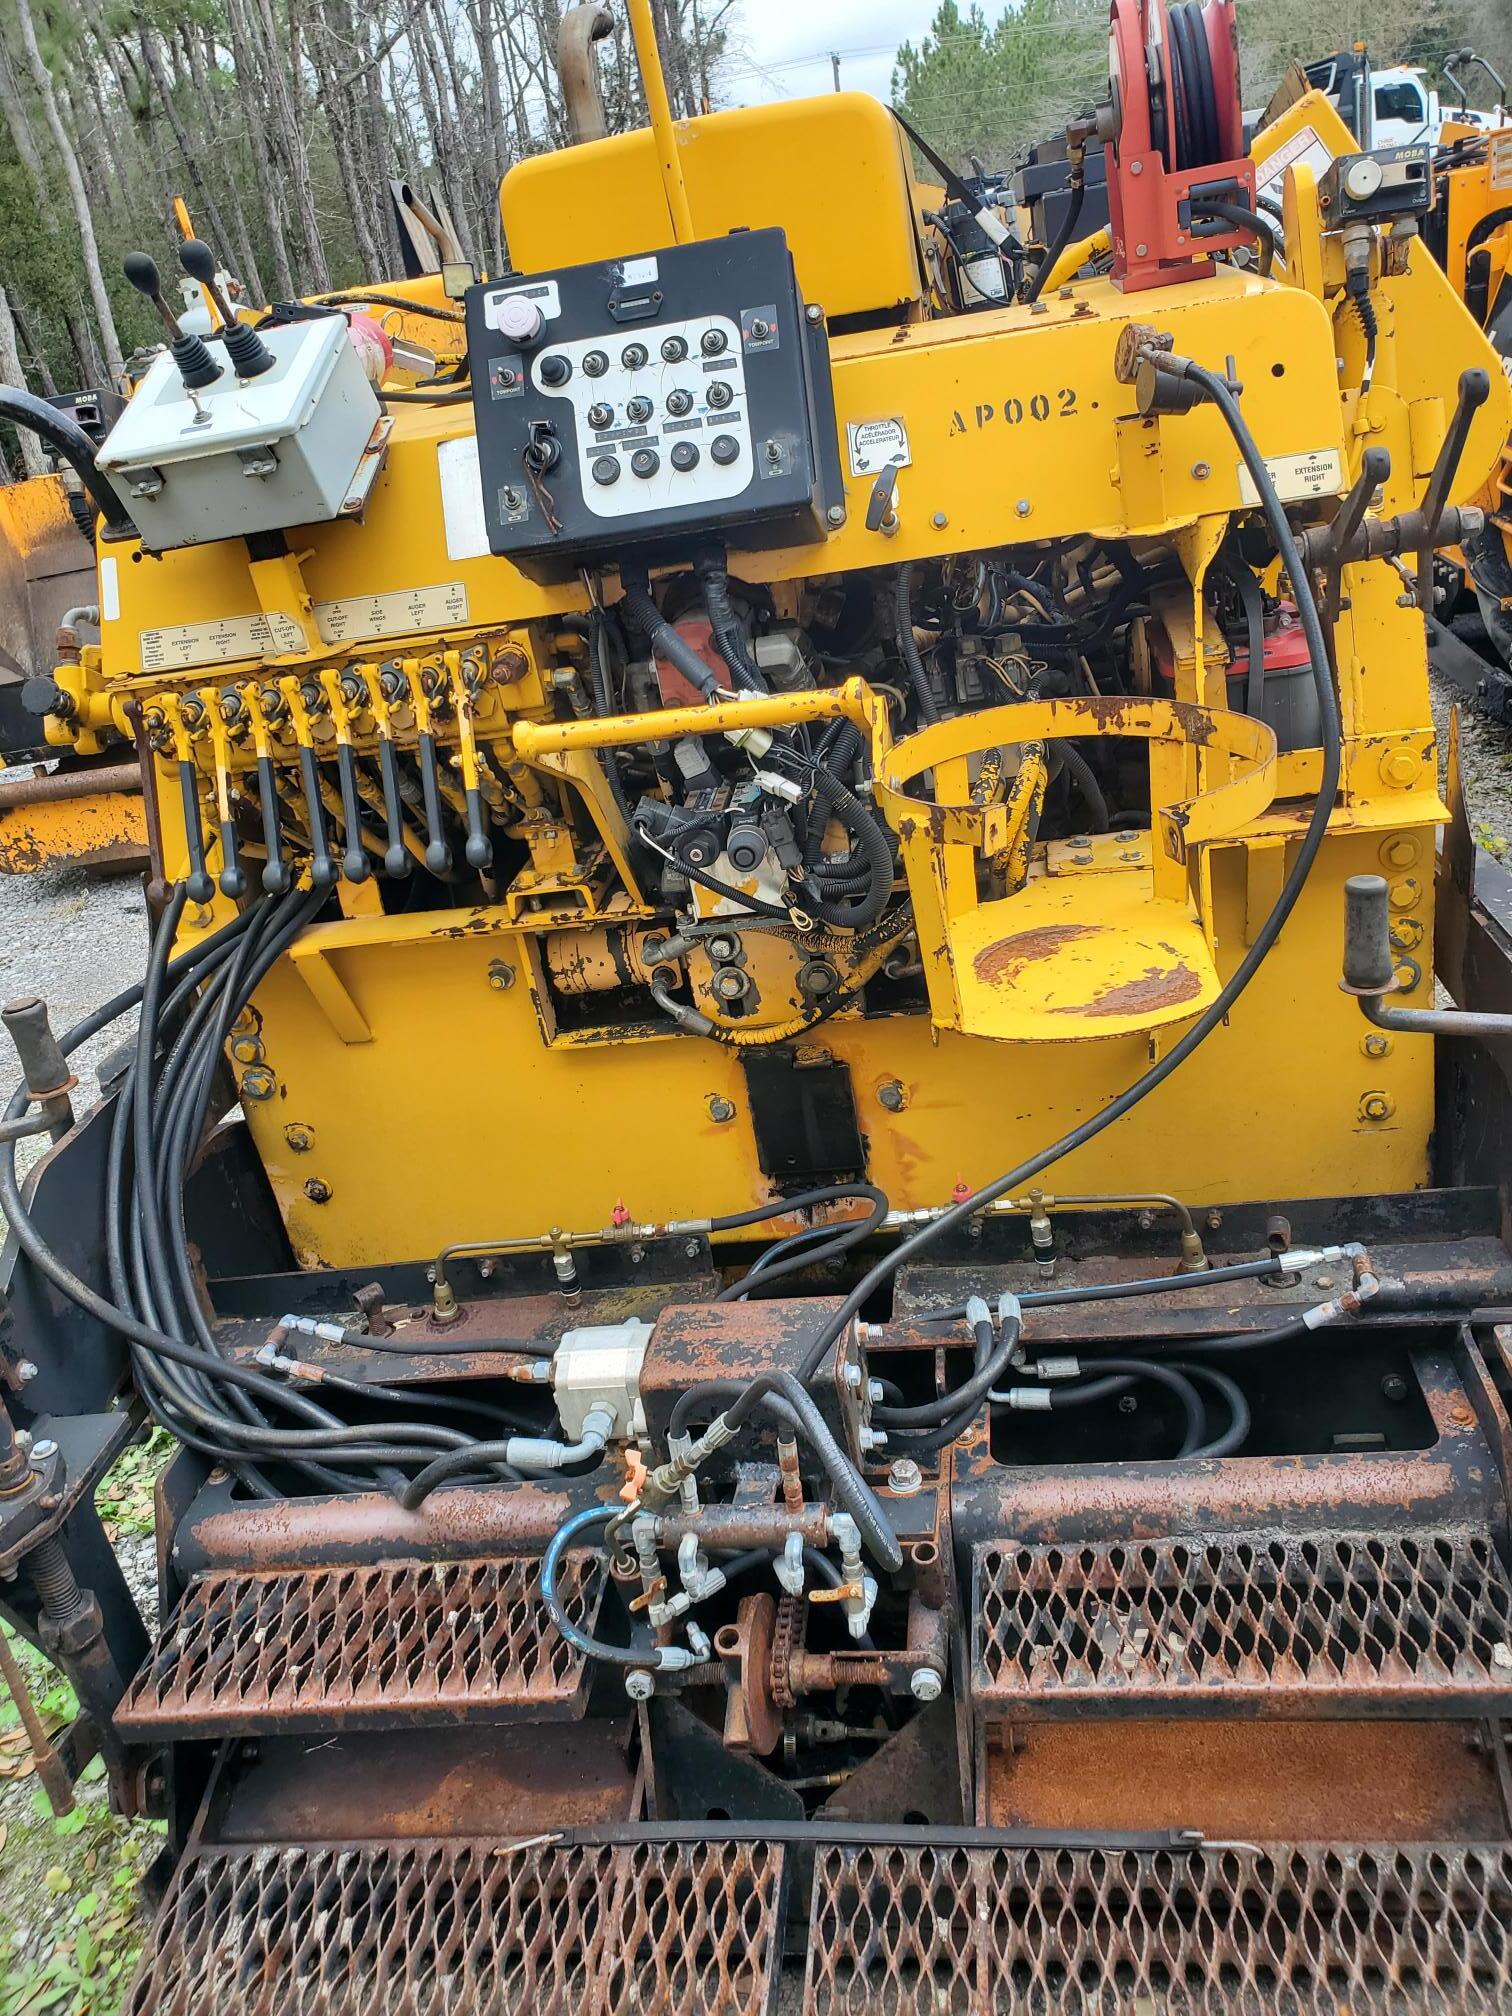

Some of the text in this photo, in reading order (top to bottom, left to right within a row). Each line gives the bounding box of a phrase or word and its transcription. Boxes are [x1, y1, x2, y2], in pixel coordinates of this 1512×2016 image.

[1395, 148, 1425, 160] MOBA
[75, 394, 98, 404] MOBA
[864, 422, 892, 432] THROTTLE
[1294, 463, 1333, 475] EXTENSION
[1304, 473, 1326, 483] RIGHT
[445, 597, 464, 605] AUGER
[407, 602, 426, 610] AUGER
[446, 603, 463, 611] RIGHT
[327, 614, 349, 623] CUT-OFF
[274, 625, 296, 633] CUT-OFF
[209, 632, 237, 641] EXTENSION
[171, 638, 200, 646] EXTENSION
